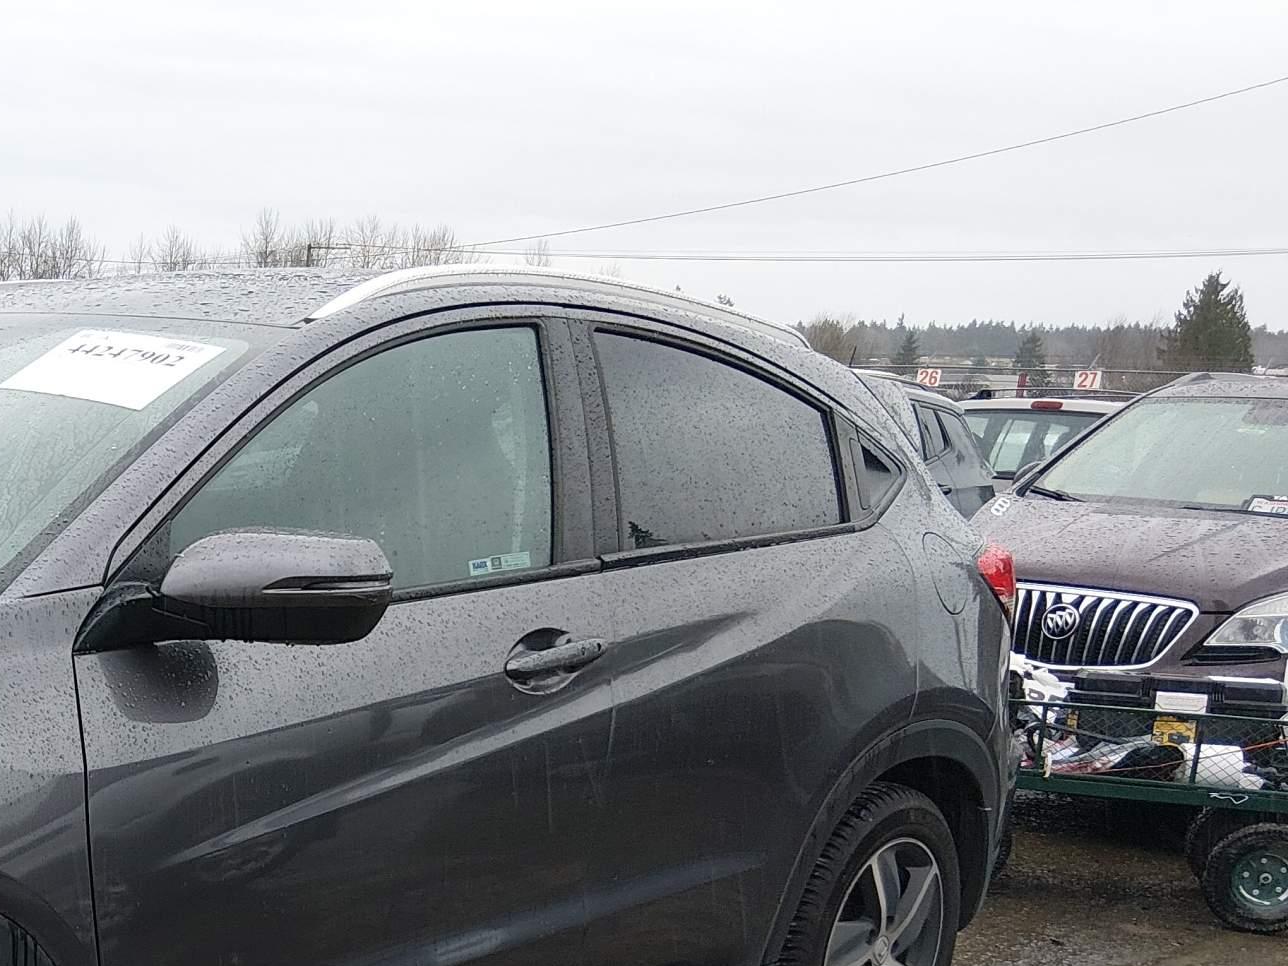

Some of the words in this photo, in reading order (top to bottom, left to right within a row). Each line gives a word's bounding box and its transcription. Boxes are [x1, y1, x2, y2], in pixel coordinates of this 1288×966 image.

[67, 344, 185, 367] 44247902
[919, 370, 938, 386] 26
[1078, 371, 1098, 388] 27
